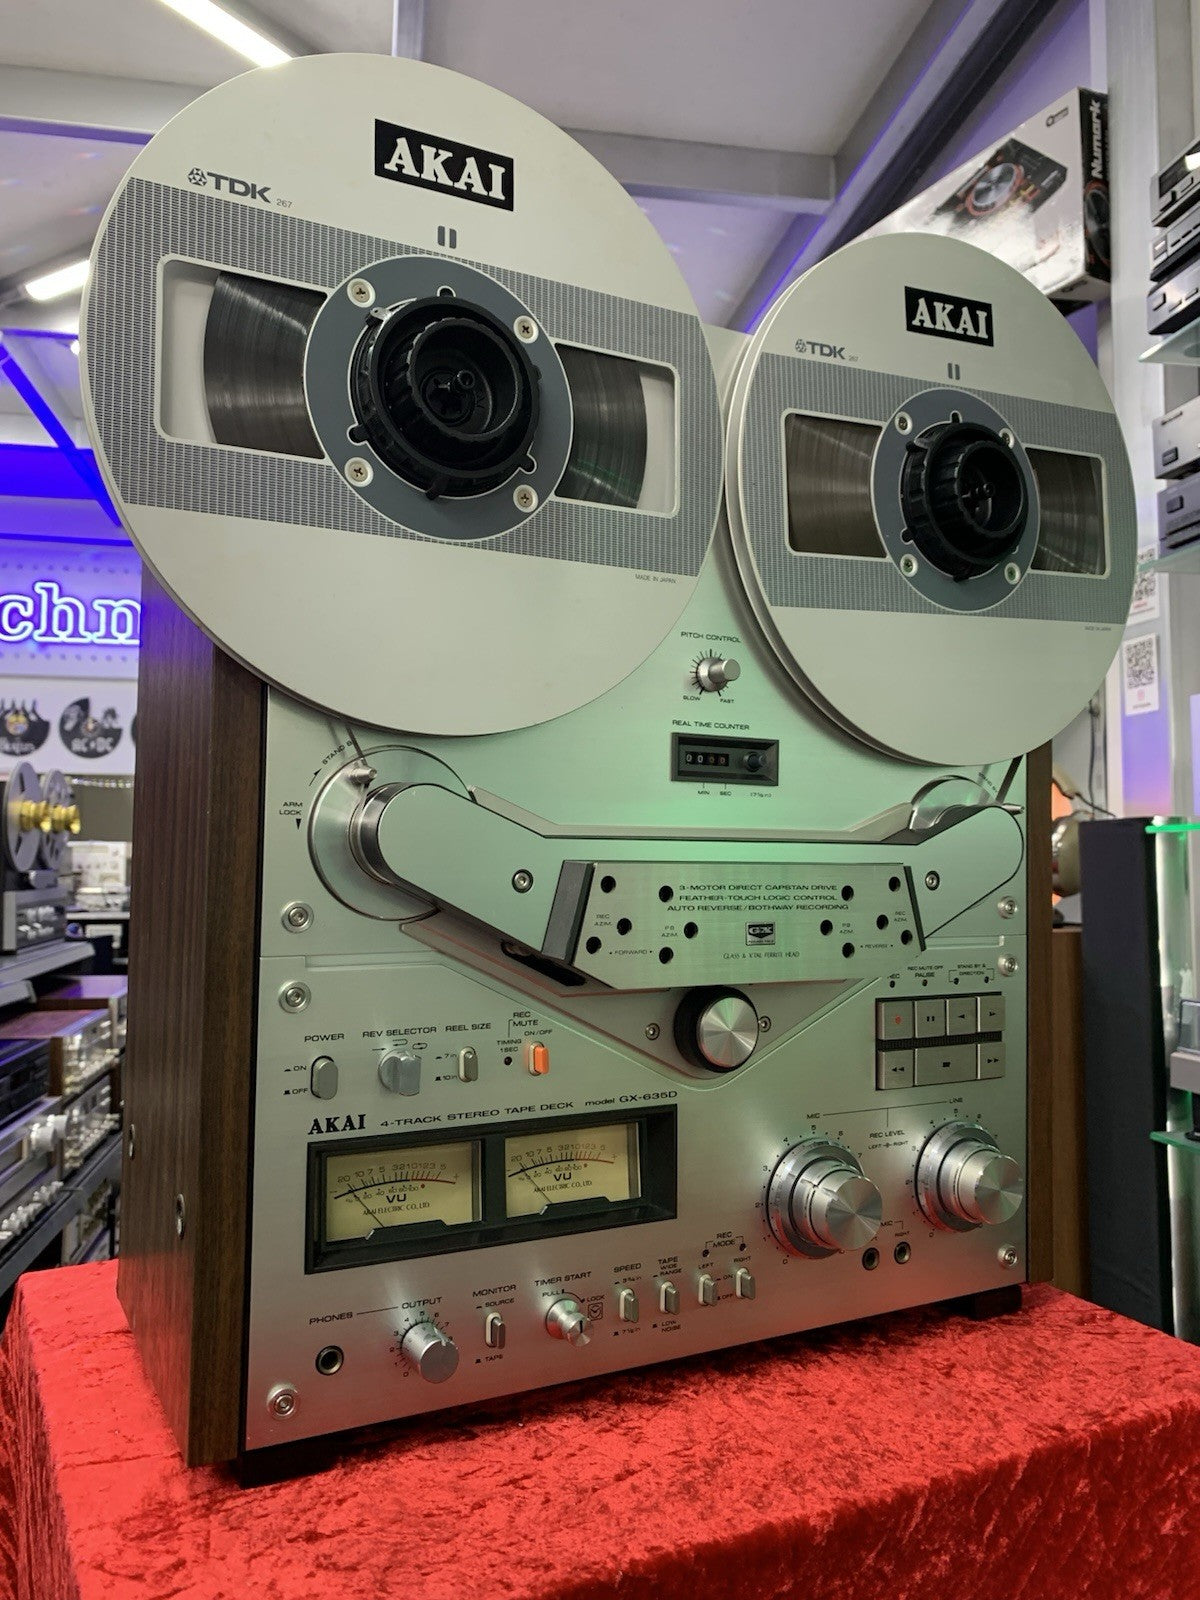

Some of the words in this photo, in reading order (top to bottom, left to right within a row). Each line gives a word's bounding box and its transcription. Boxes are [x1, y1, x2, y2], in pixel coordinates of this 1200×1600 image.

[1089, 99, 1103, 179] Numark
[384, 136, 507, 202] AKAI
[206, 171, 271, 204] TDK
[276, 198, 292, 208] 267
[911, 297, 989, 339] AKAI
[806, 341, 845, 360] TDK
[680, 631, 704, 640] PITCH
[706, 634, 742, 643] CONTROL
[672, 719, 692, 727] REAL
[714, 722, 750, 731] COUNTER
[321, 744, 346, 766] STAND
[748, 925, 774, 935] GX
[445, 1024, 470, 1032] REEL
[471, 1022, 492, 1031] SIZE
[513, 1019, 539, 1027] MUTE
[363, 1030, 384, 1038] REV
[386, 1026, 437, 1037] SELECTOR
[304, 1033, 345, 1043] POWER
[496, 1038, 522, 1046] TIMING
[292, 1087, 309, 1095] OFF
[308, 1114, 366, 1135] AKAI
[380, 1114, 442, 1128] 4-TRACK
[447, 1109, 501, 1122] STEREO
[504, 1105, 537, 1115] TAPE
[540, 1101, 575, 1111] DECK
[585, 1097, 616, 1107] model
[619, 1090, 678, 1103] GX-635D
[806, 1112, 821, 1120] MIC
[868, 1131, 884, 1139] REC
[884, 1129, 906, 1138] LEVEL
[337, 1174, 351, 1183] 20
[355, 1170, 365, 1178] 10
[553, 1172, 572, 1181] VU
[386, 1193, 407, 1204] VU
[716, 1230, 733, 1240] REC
[712, 1238, 736, 1249] MODE
[657, 1256, 679, 1265] TAPE
[698, 1261, 715, 1270] LEFT
[733, 1255, 752, 1264] RIGHT
[613, 1262, 642, 1274] SPEED
[659, 1267, 683, 1277] RANGE
[660, 1263, 678, 1271] WIDE
[534, 1277, 562, 1288] TIMER
[564, 1270, 592, 1282] START
[722, 1273, 733, 1281] ON
[472, 1284, 517, 1298] MONITOR
[542, 1289, 560, 1298] PULL
[586, 1294, 605, 1303] LOCK
[721, 1292, 734, 1301] OFF
[401, 1296, 443, 1310] OUTPUT
[485, 1297, 515, 1308] SOURCE
[309, 1311, 353, 1325] PHONES
[661, 1319, 678, 1327] LOW
[661, 1324, 682, 1334] NOISE
[485, 1354, 504, 1363] TAPE
